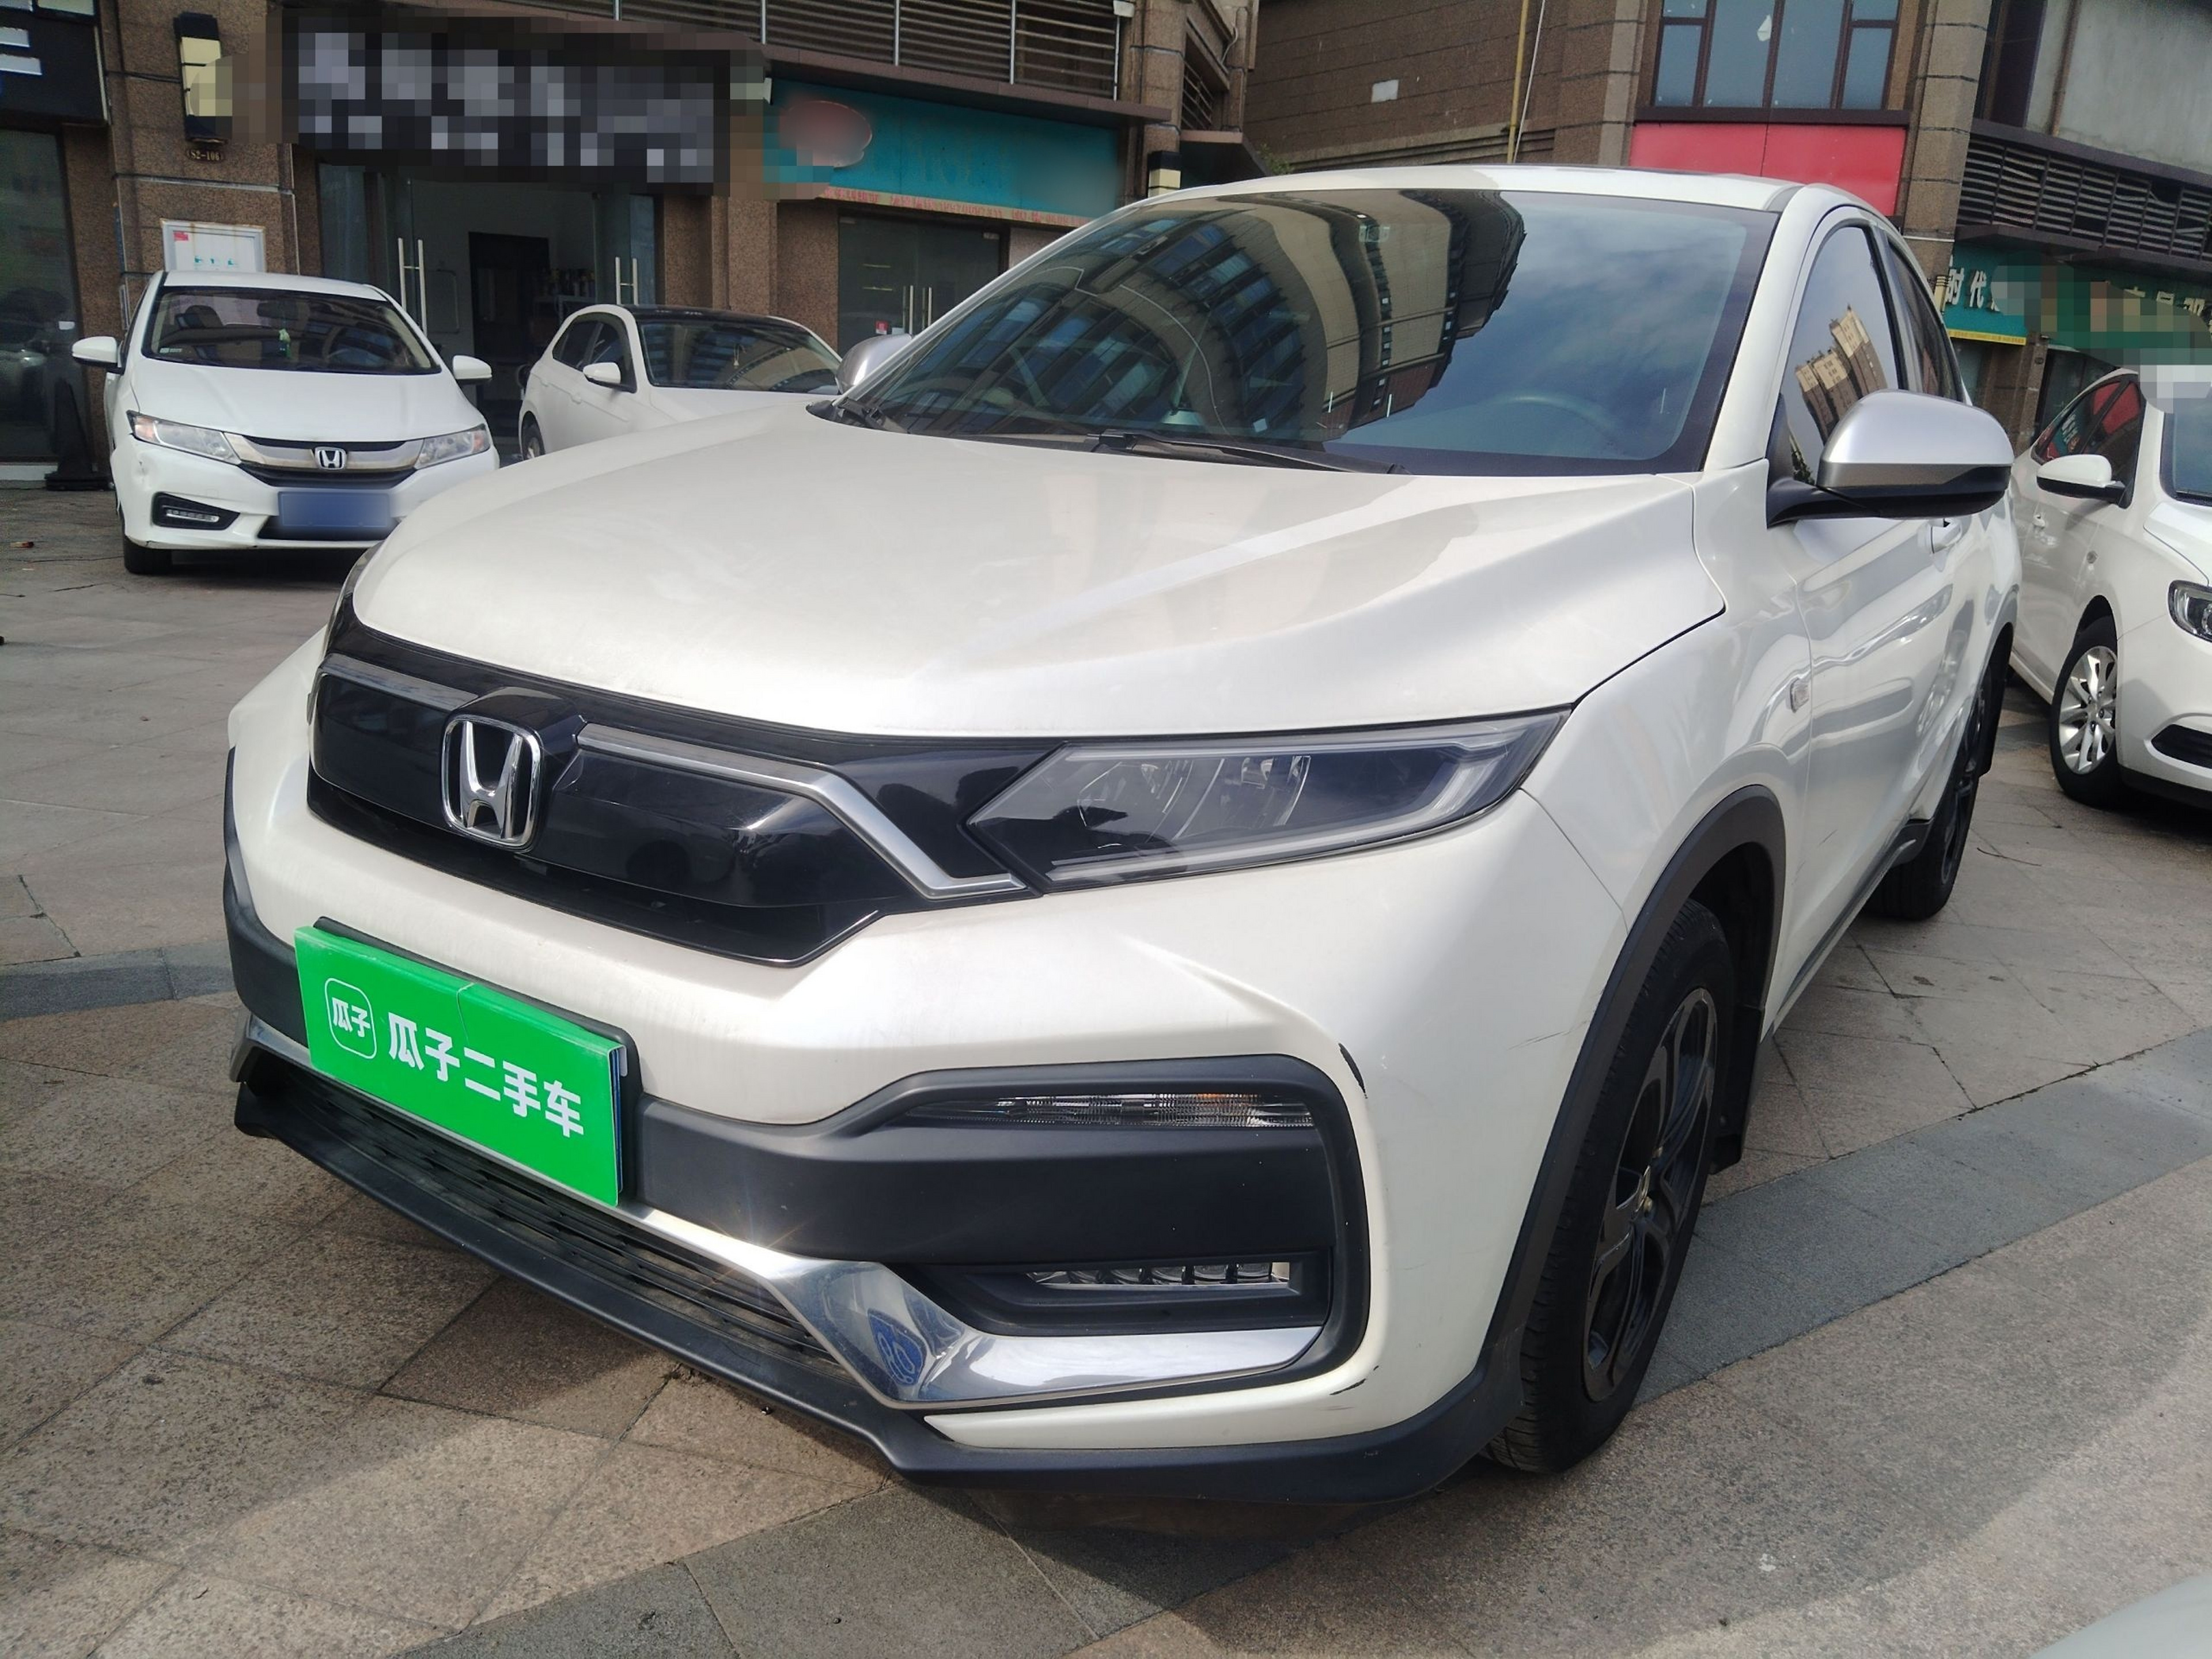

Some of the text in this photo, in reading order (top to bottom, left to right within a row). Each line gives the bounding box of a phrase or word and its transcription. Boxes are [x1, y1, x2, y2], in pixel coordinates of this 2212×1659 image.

[1945, 267, 2000, 312] 时代
[332, 997, 370, 1038] 瓜子
[388, 1012, 584, 1138] 瓜子二手车
